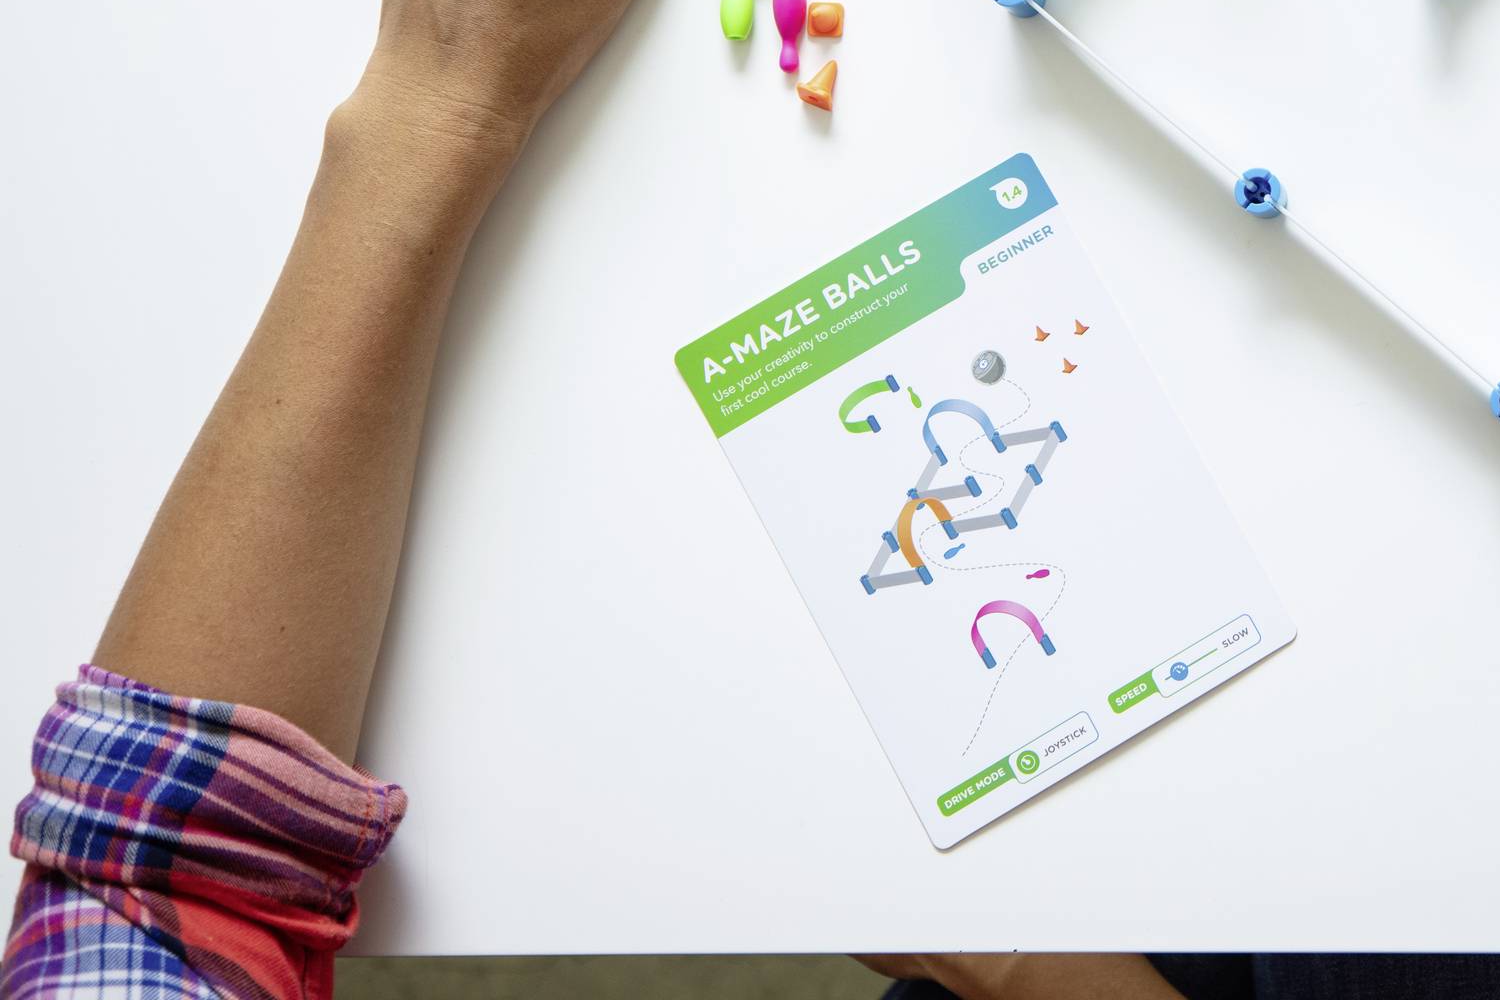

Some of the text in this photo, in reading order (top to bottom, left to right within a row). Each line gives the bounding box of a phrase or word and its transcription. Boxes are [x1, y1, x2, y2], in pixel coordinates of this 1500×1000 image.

[1001, 185, 1022, 202] 1.4
[977, 225, 1054, 274] BEGINNER
[703, 240, 921, 384] A-MAZE BALLS
[712, 283, 909, 402] Use your creativity to construct your
[720, 360, 813, 417] first cool course.
[1115, 627, 1249, 706] SPEED SLOW
[943, 725, 1087, 809] DRIVE MODE JOYSTICK
